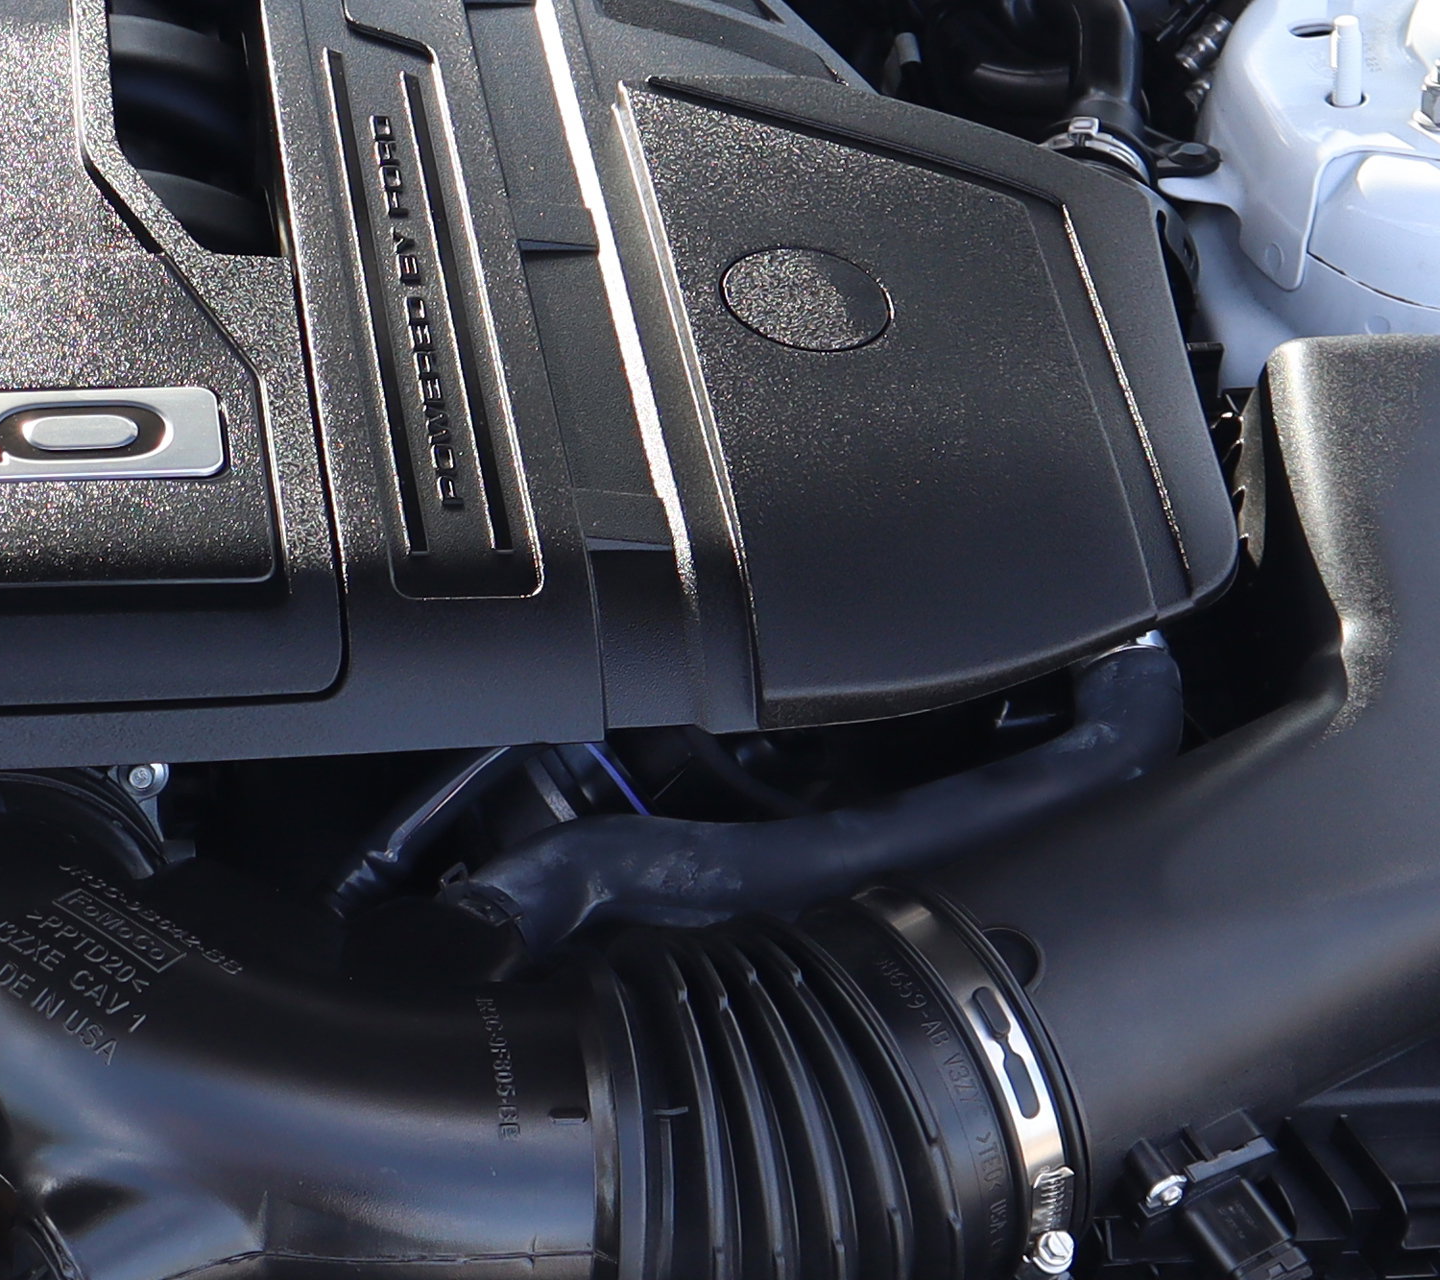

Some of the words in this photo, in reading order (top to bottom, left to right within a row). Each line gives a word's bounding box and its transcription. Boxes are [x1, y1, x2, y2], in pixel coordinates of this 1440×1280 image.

[369, 114, 409, 217] FORD
[390, 227, 422, 286] BY
[403, 296, 466, 510] POWERED
[68, 893, 167, 961] FoMoCo
[30, 987, 66, 1020] IN
[63, 1008, 119, 1066] USA
[70, 970, 131, 1014] CAV
